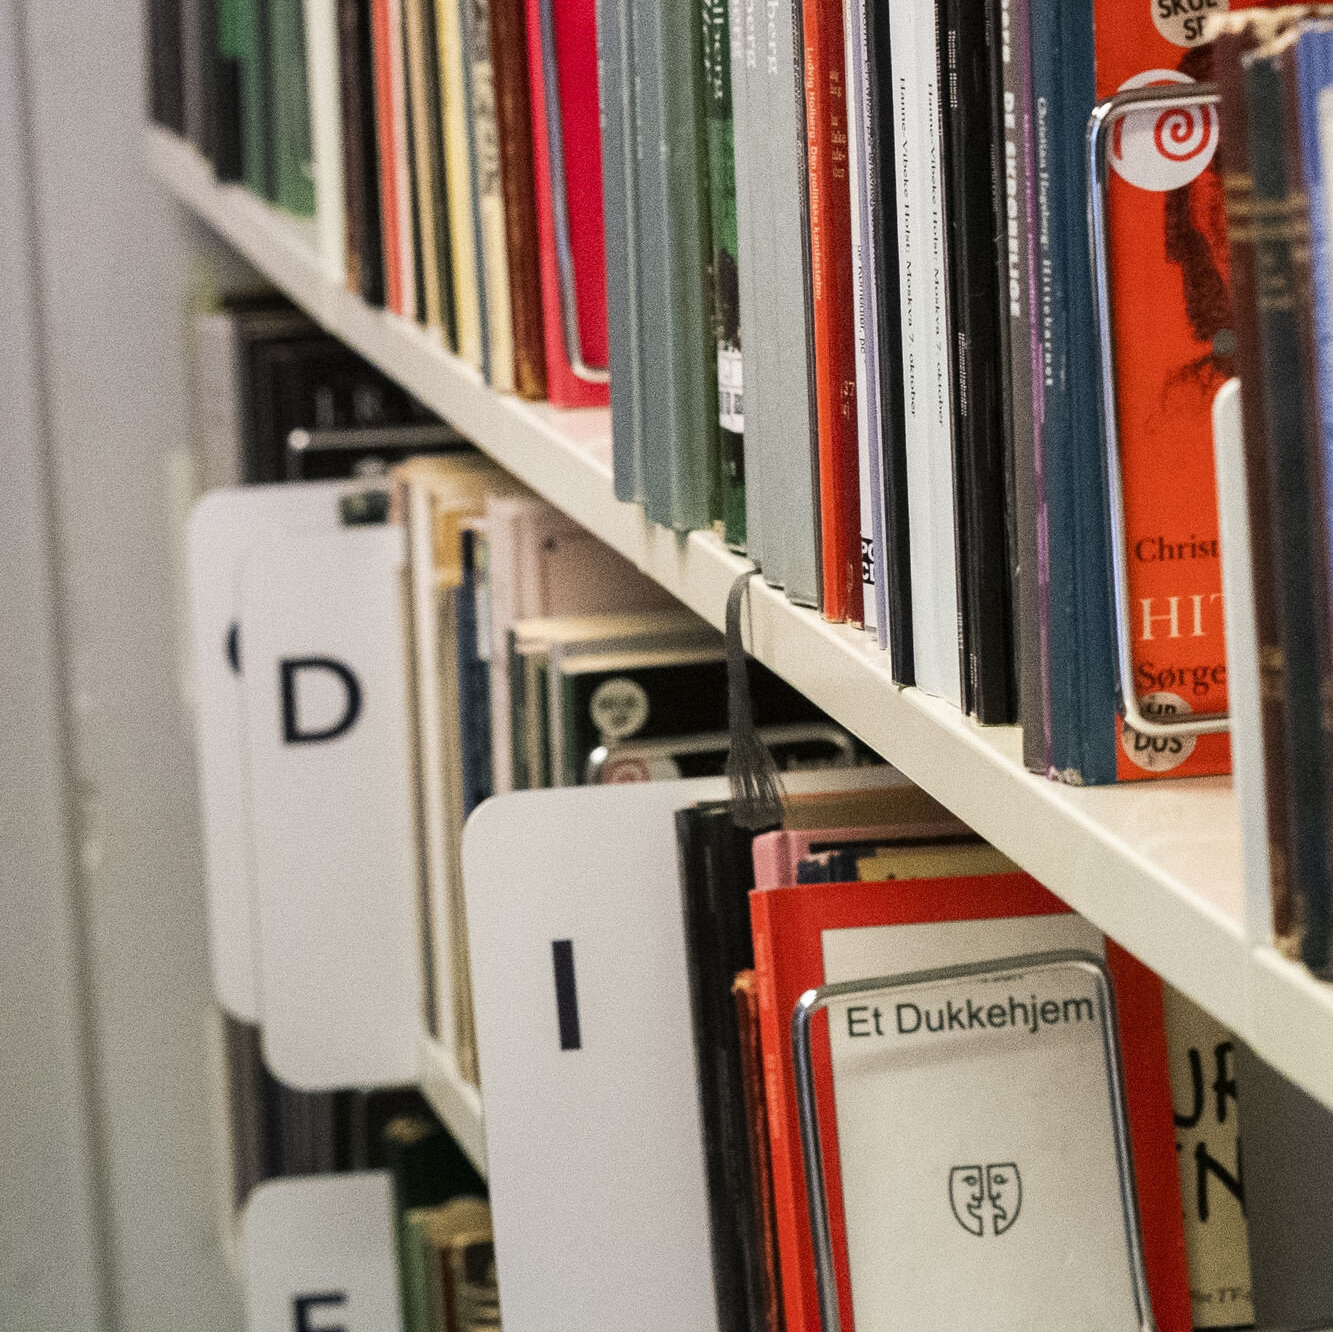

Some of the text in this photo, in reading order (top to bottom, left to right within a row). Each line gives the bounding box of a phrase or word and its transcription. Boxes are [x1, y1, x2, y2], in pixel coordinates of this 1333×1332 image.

[1004, 90, 1015, 130] DE
[279, 655, 363, 745] D
[550, 938, 583, 1051] I
[846, 993, 1095, 1039] Et Dukkehjem
